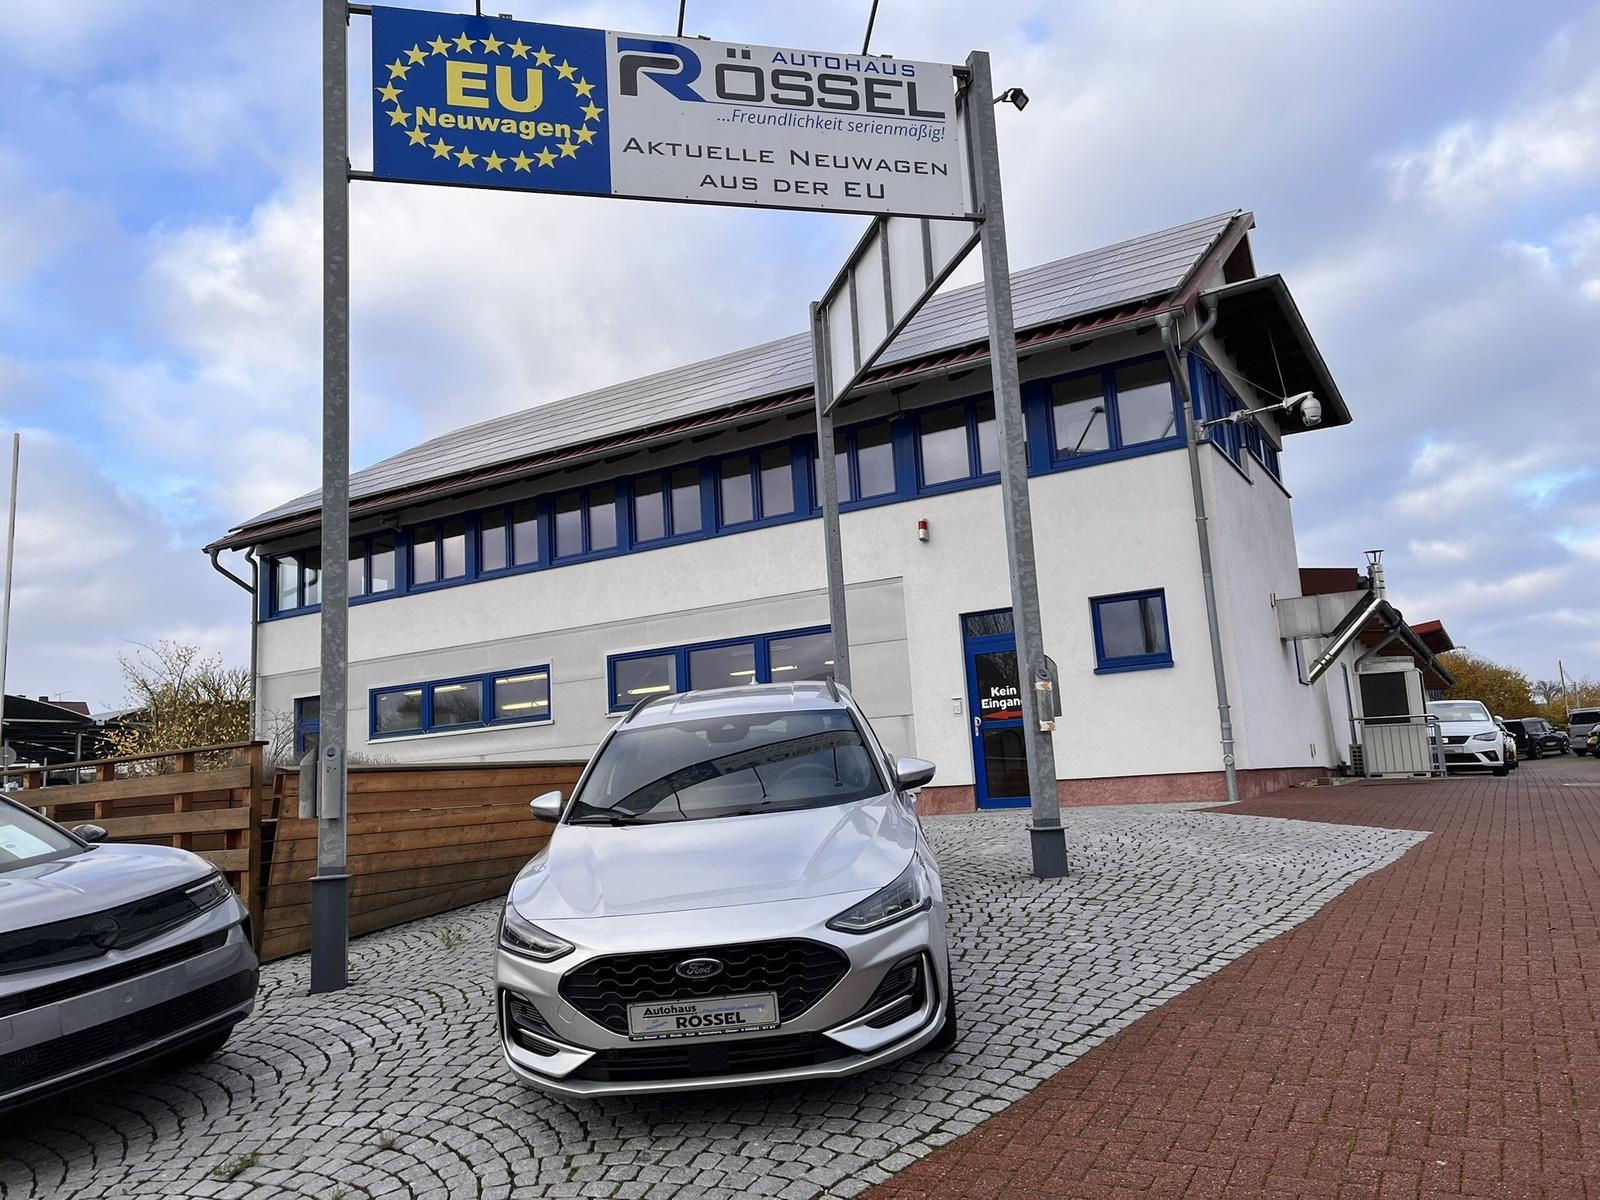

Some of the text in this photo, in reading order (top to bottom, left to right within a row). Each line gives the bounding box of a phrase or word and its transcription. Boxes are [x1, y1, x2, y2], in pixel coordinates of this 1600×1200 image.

[771, 51, 916, 77] AUTOHAUS
[446, 60, 544, 113] EU
[617, 37, 946, 118] RÖSSEL
[415, 106, 571, 140] Neuwagen
[717, 108, 946, 142] ...Freundlichkeit serienmäßig!
[699, 174, 886, 199] AUS DER EU
[981, 698, 1023, 710] Eingan
[991, 686, 1017, 697] Kein
[686, 961, 713, 976] Ford
[643, 1005, 697, 1016] Autohaus
[676, 1012, 746, 1029] RÖSSEL
